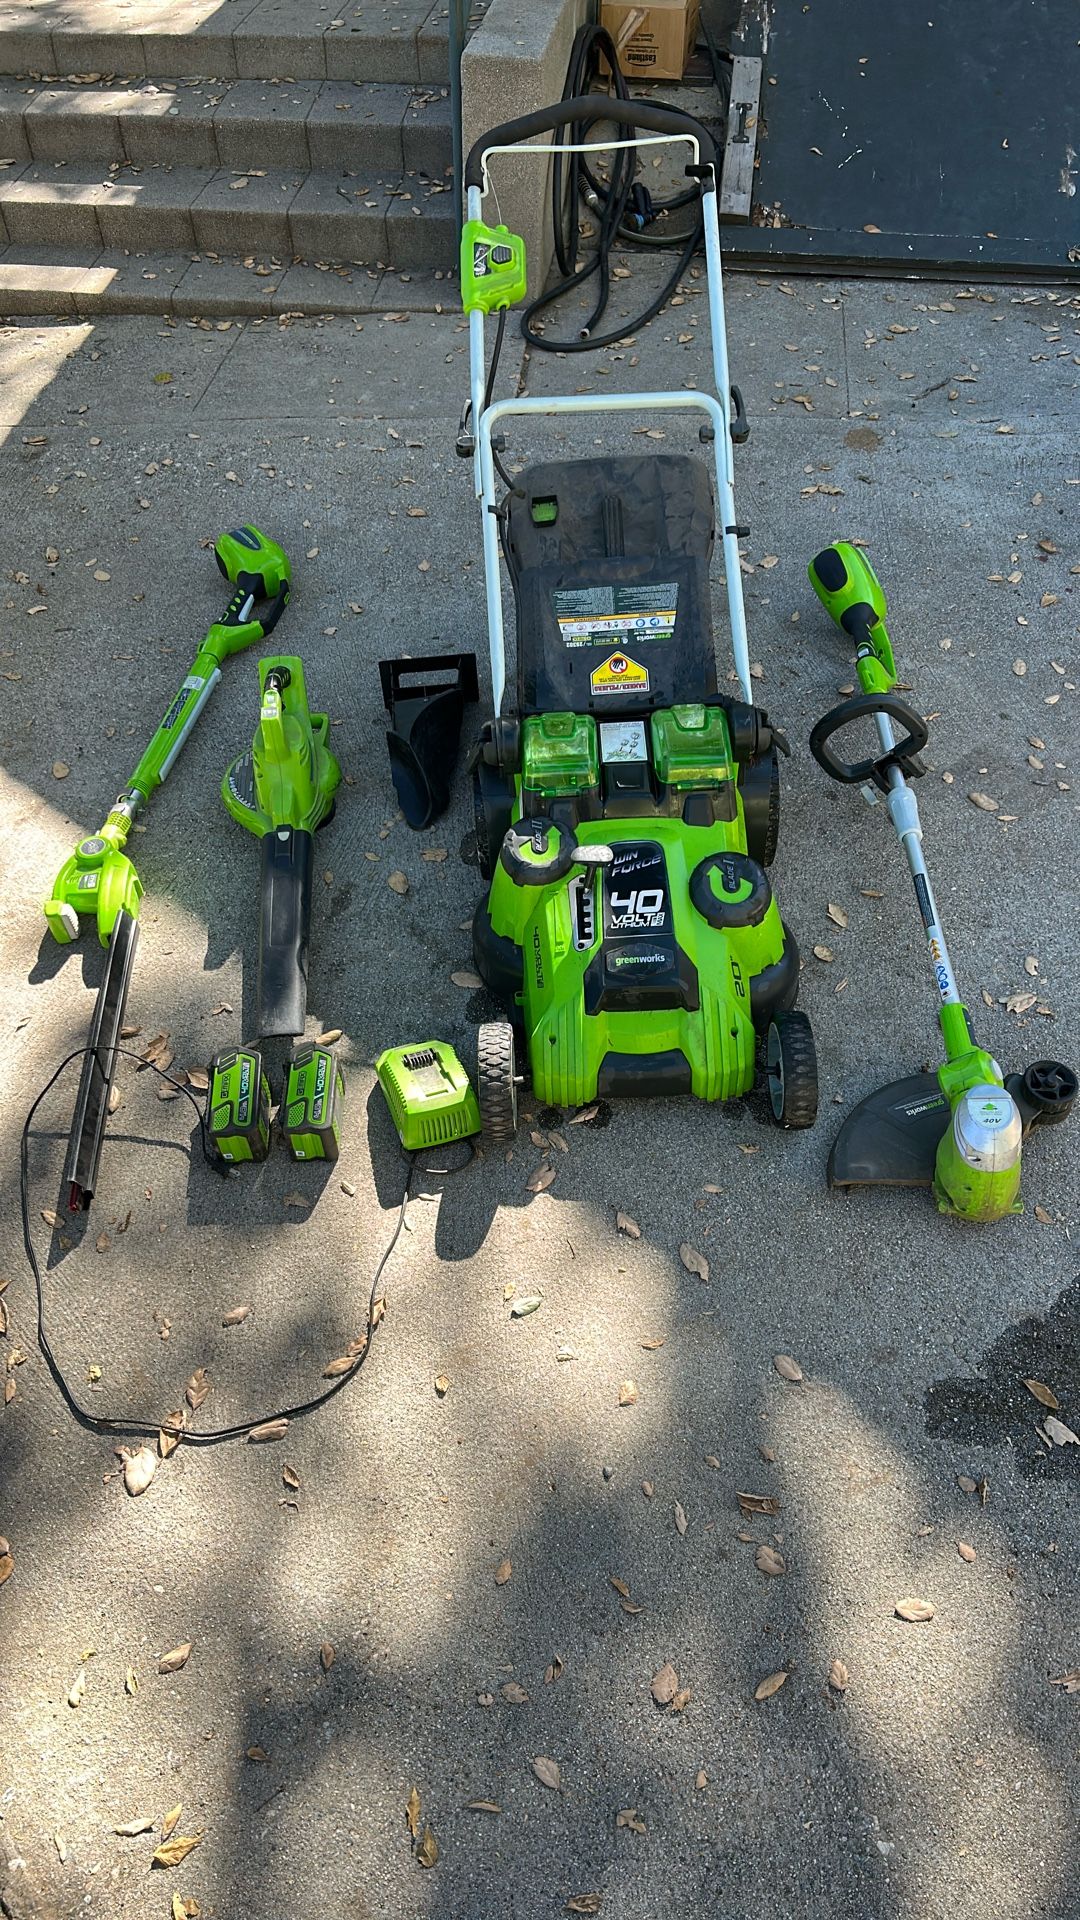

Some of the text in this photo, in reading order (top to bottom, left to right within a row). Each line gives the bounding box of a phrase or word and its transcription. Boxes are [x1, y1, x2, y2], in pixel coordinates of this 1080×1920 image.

[627, 54, 656, 63] Eastland
[636, 632, 672, 642] greenworks
[535, 830, 543, 851] BLADE
[607, 849, 639, 867] WIN
[611, 854, 662, 878] FORCE
[727, 865, 736, 889] BLADE
[610, 888, 664, 914] 40
[610, 920, 650, 929] LITHIUM
[611, 913, 656, 924] VOLT
[615, 953, 666, 967] greenworks
[905, 1098, 945, 1117] greenworks
